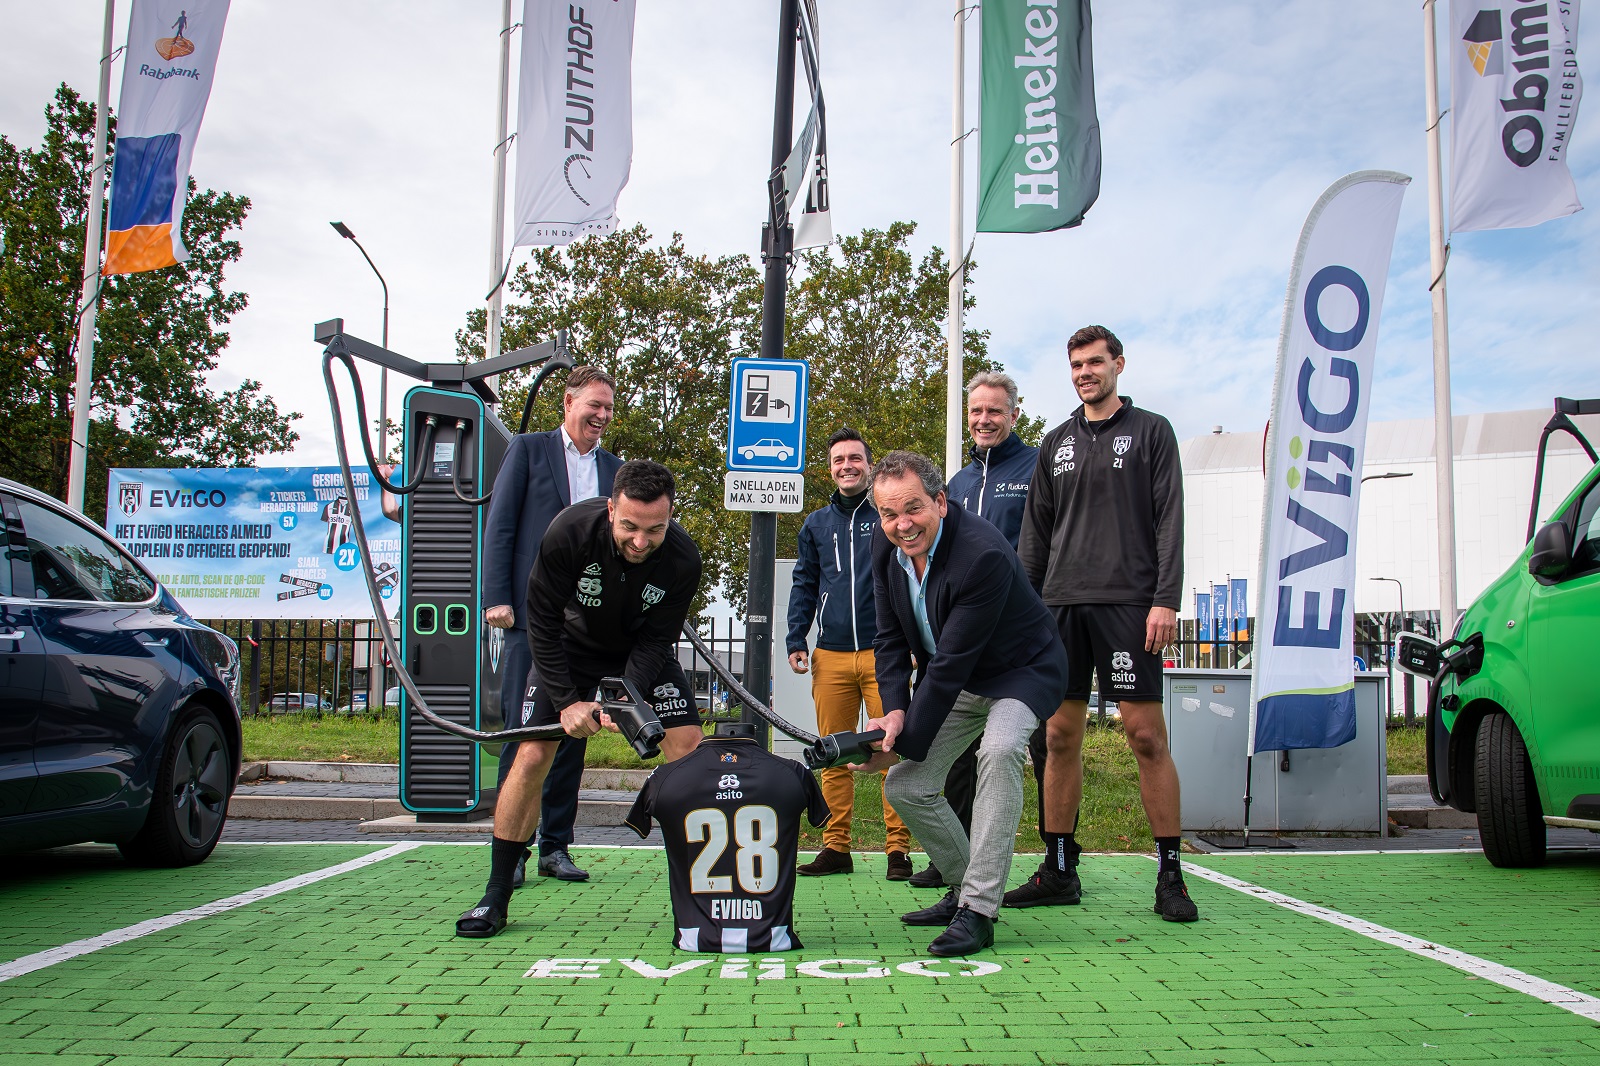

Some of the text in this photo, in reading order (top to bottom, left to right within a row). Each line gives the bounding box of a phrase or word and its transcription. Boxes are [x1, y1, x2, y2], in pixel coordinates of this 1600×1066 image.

[140, 64, 200, 80] Rabobank
[565, 4, 593, 152] ZUITHOF
[1500, 0, 1549, 167] Obim
[1015, 0, 1059, 209] Heineke
[1054, 461, 1075, 477] asito
[1113, 457, 1124, 469] 21
[733, 480, 796, 492] SNELLADEN
[270, 491, 306, 502] 2 TICKETS
[730, 492, 799, 505] MAX. 30 MIN
[261, 502, 318, 513] HERACLES THUIS
[284, 516, 295, 528] 5X
[115, 524, 135, 539] HET
[175, 524, 229, 540] HERACLES
[231, 524, 272, 540] ALMELO
[173, 543, 184, 558] IS
[187, 543, 236, 559] OFFICIEEL
[239, 543, 291, 558] GEOPEND!
[297, 557, 319, 568] SJAAL
[339, 549, 355, 566] 2X
[171, 575, 179, 584] JE
[180, 575, 201, 586] AUTO,
[203, 575, 222, 585] SCAN
[224, 575, 233, 585] DE
[234, 575, 266, 585] QR-CODE
[289, 569, 327, 580] HERACLES
[177, 588, 228, 598] FANTASTISCHE
[230, 588, 260, 598] PRIJZEN!
[1111, 670, 1136, 682] asito
[527, 686, 537, 697] 17
[655, 698, 688, 712] asito
[716, 790, 743, 800] asito
[684, 805, 779, 894] 28
[711, 900, 762, 920] EVIIGO
